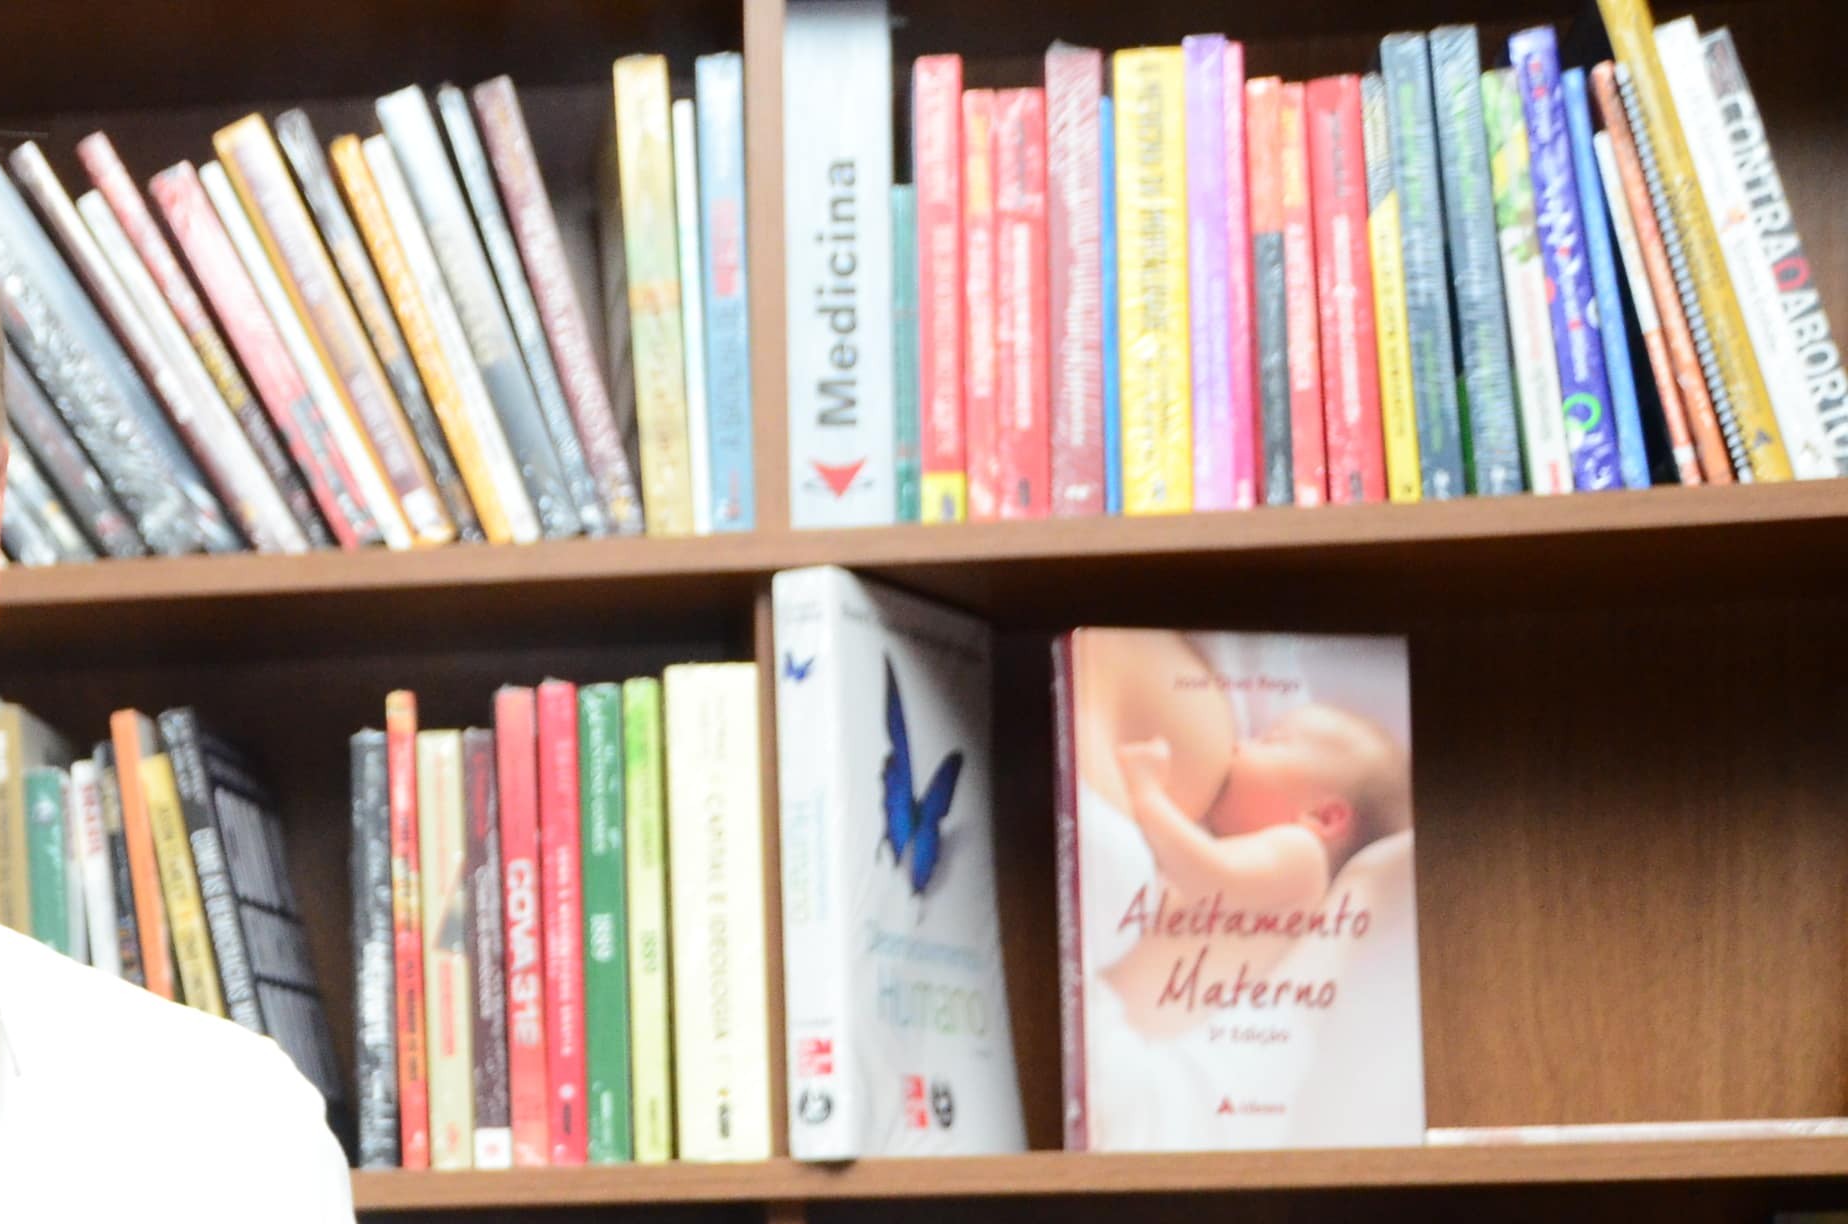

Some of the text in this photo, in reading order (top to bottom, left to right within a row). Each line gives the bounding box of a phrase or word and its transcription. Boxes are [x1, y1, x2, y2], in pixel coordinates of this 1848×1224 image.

[1718, 94, 1790, 259] CONTRA
[1772, 255, 1812, 293] O
[814, 157, 861, 429] Medicina
[207, 896, 250, 1003] DEMOCRACIAS
[506, 858, 540, 970] COVA
[590, 913, 614, 962] 1889
[1117, 883, 1373, 941] Aleitamento
[1157, 946, 1338, 1013] Materno
